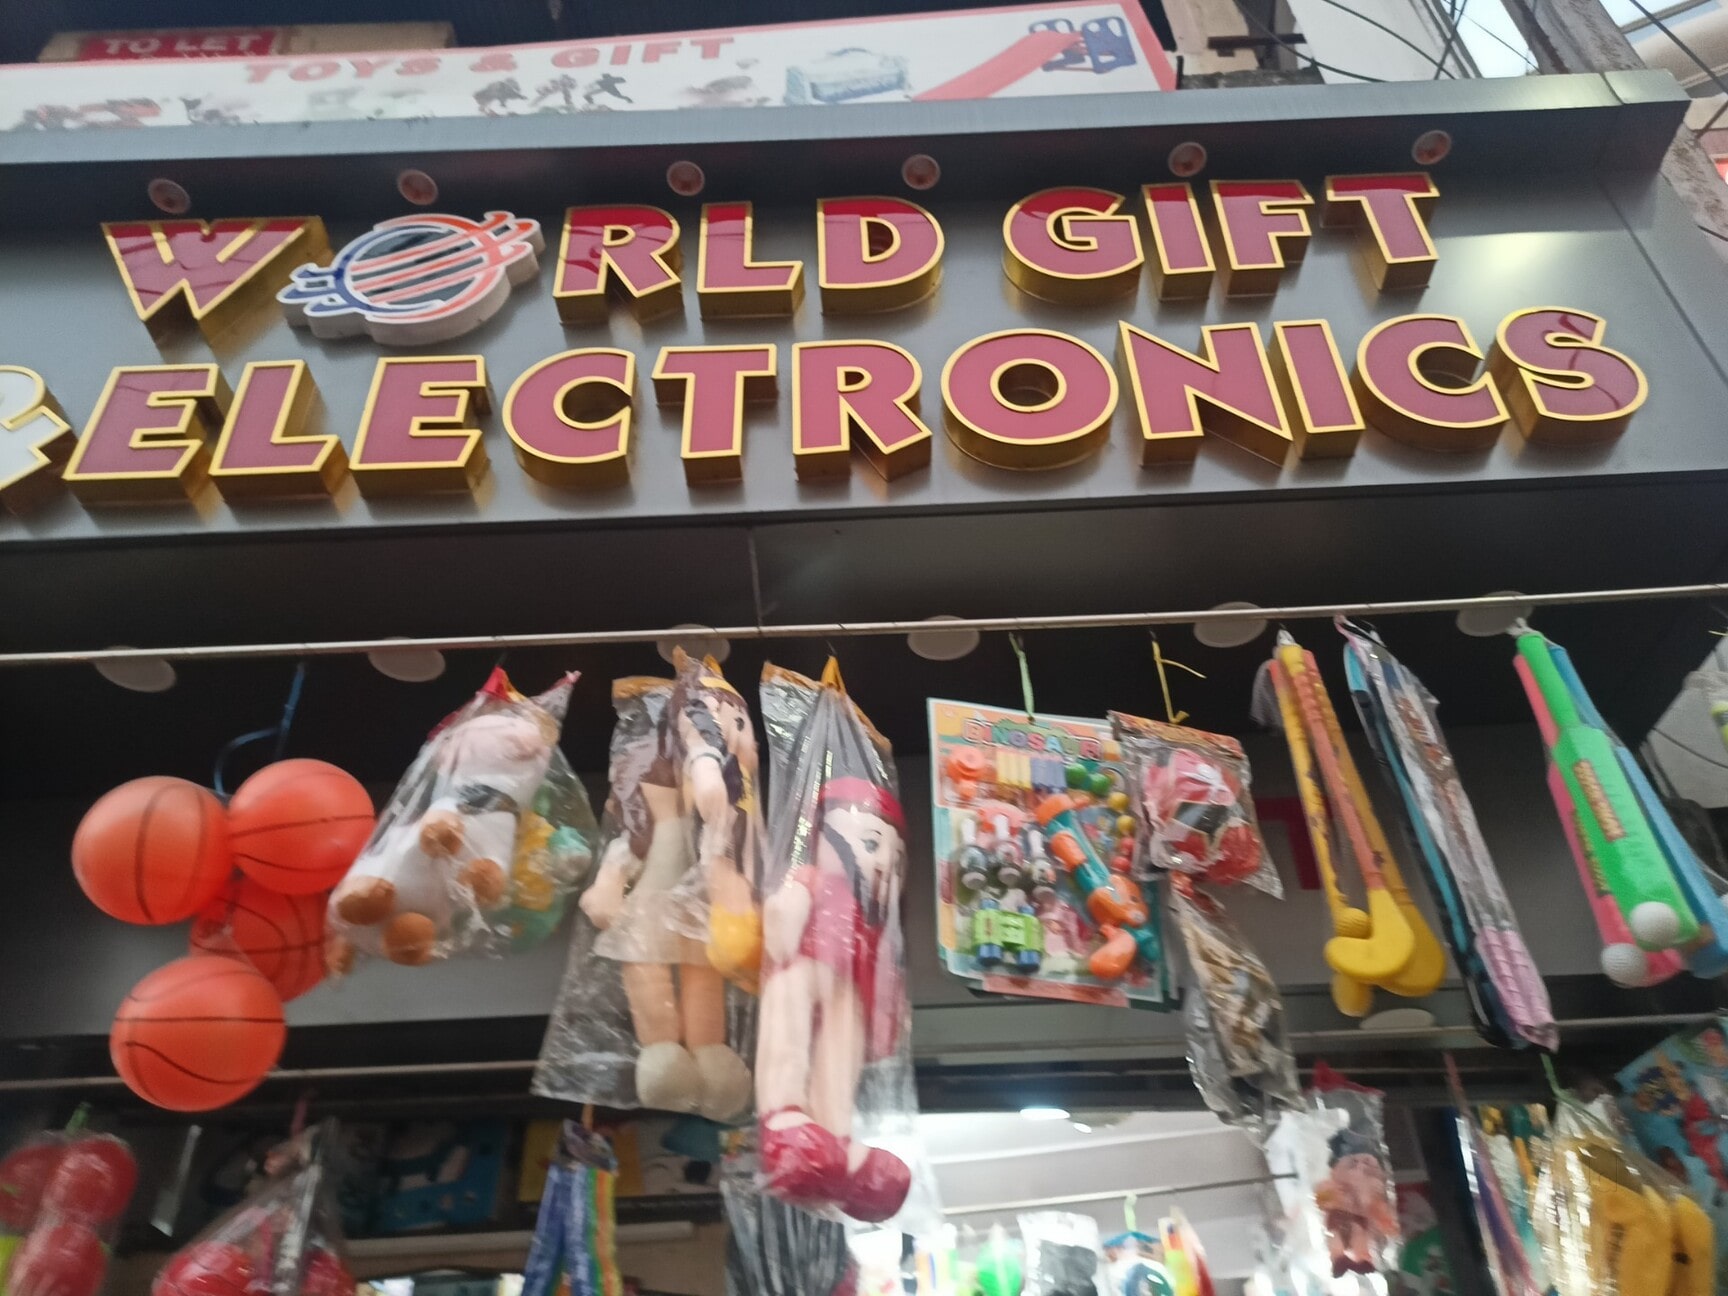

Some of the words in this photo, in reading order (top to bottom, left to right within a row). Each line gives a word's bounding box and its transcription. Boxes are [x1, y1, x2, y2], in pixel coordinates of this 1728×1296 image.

[105, 37, 161, 54] TO
[174, 34, 262, 51] LET
[245, 56, 441, 84] TOYS
[470, 52, 518, 73] &
[551, 37, 735, 69] GIFT
[1002, 172, 1440, 282] GIFT
[63, 306, 1649, 482] ELECTRONICS
